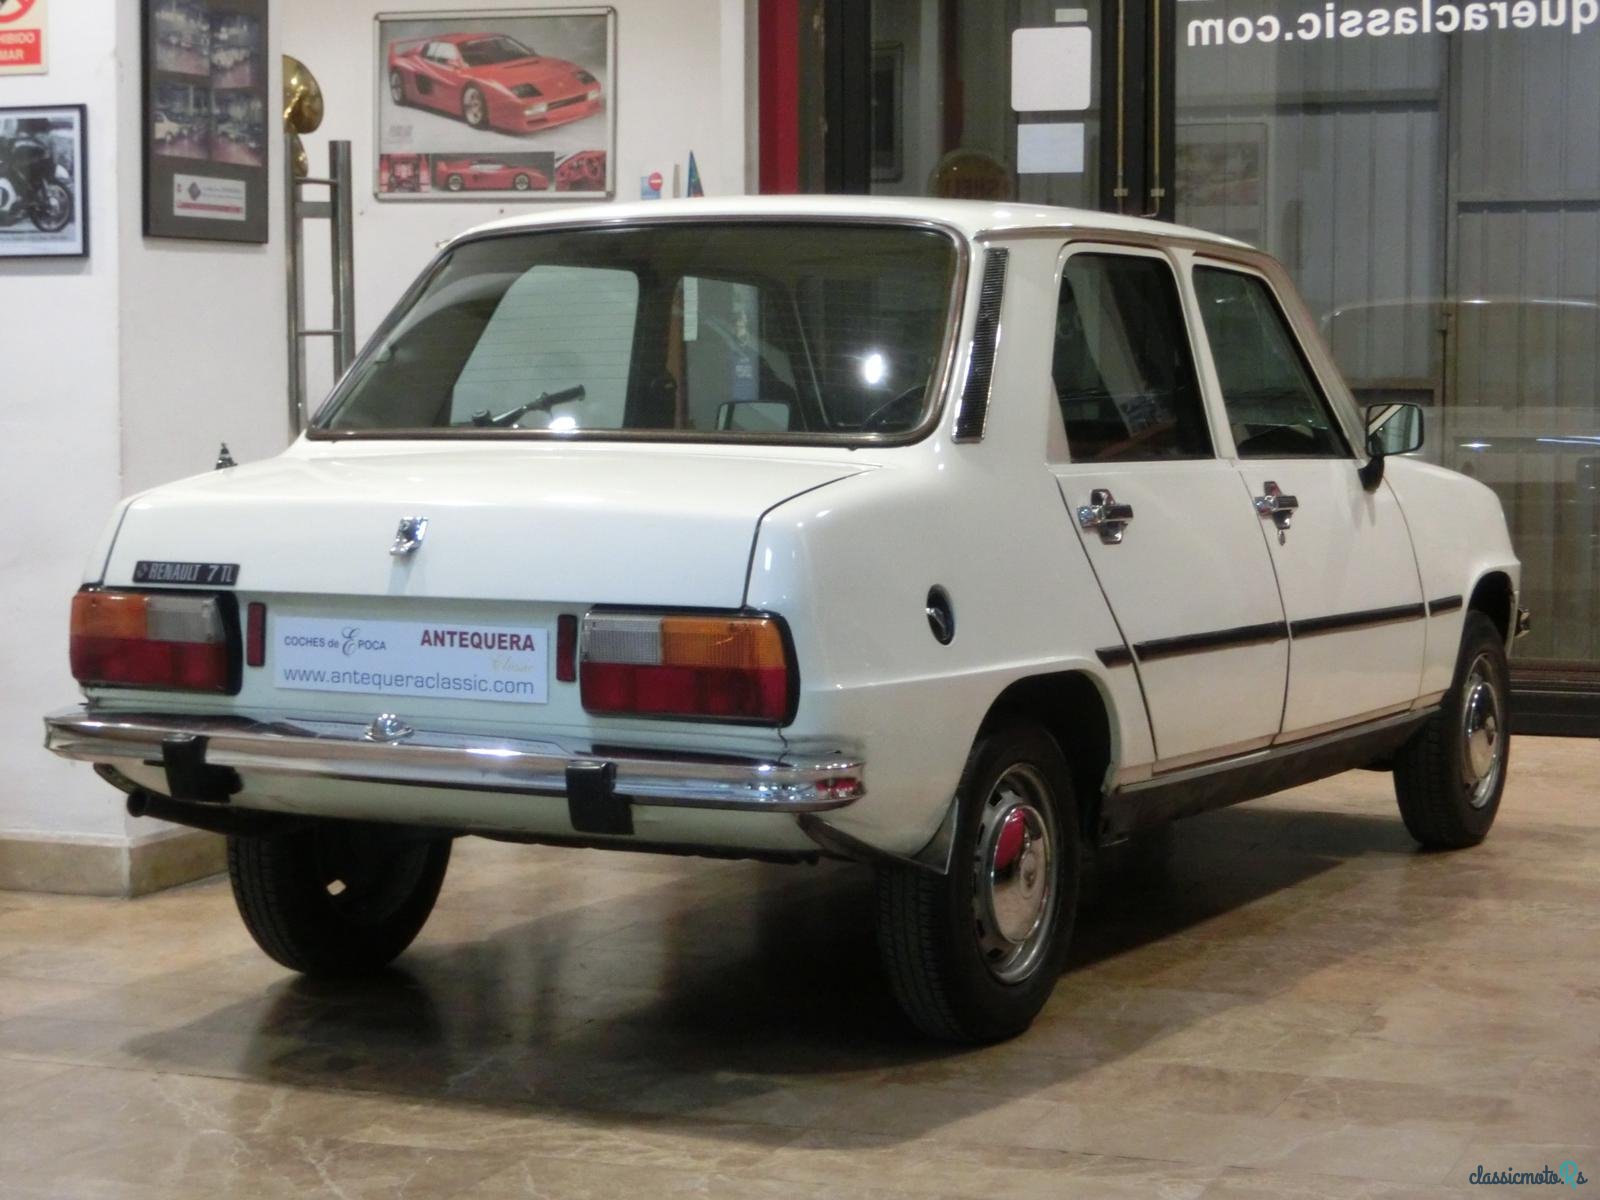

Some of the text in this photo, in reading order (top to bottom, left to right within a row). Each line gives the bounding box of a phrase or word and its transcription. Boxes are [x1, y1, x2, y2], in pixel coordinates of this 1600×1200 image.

[148, 562, 234, 583] RENAULT 7 TL
[284, 635, 325, 648] COCHES
[327, 638, 339, 648] de
[421, 629, 535, 651] ANTEQUERA
[283, 667, 534, 694] www.antequeraclassic.com
